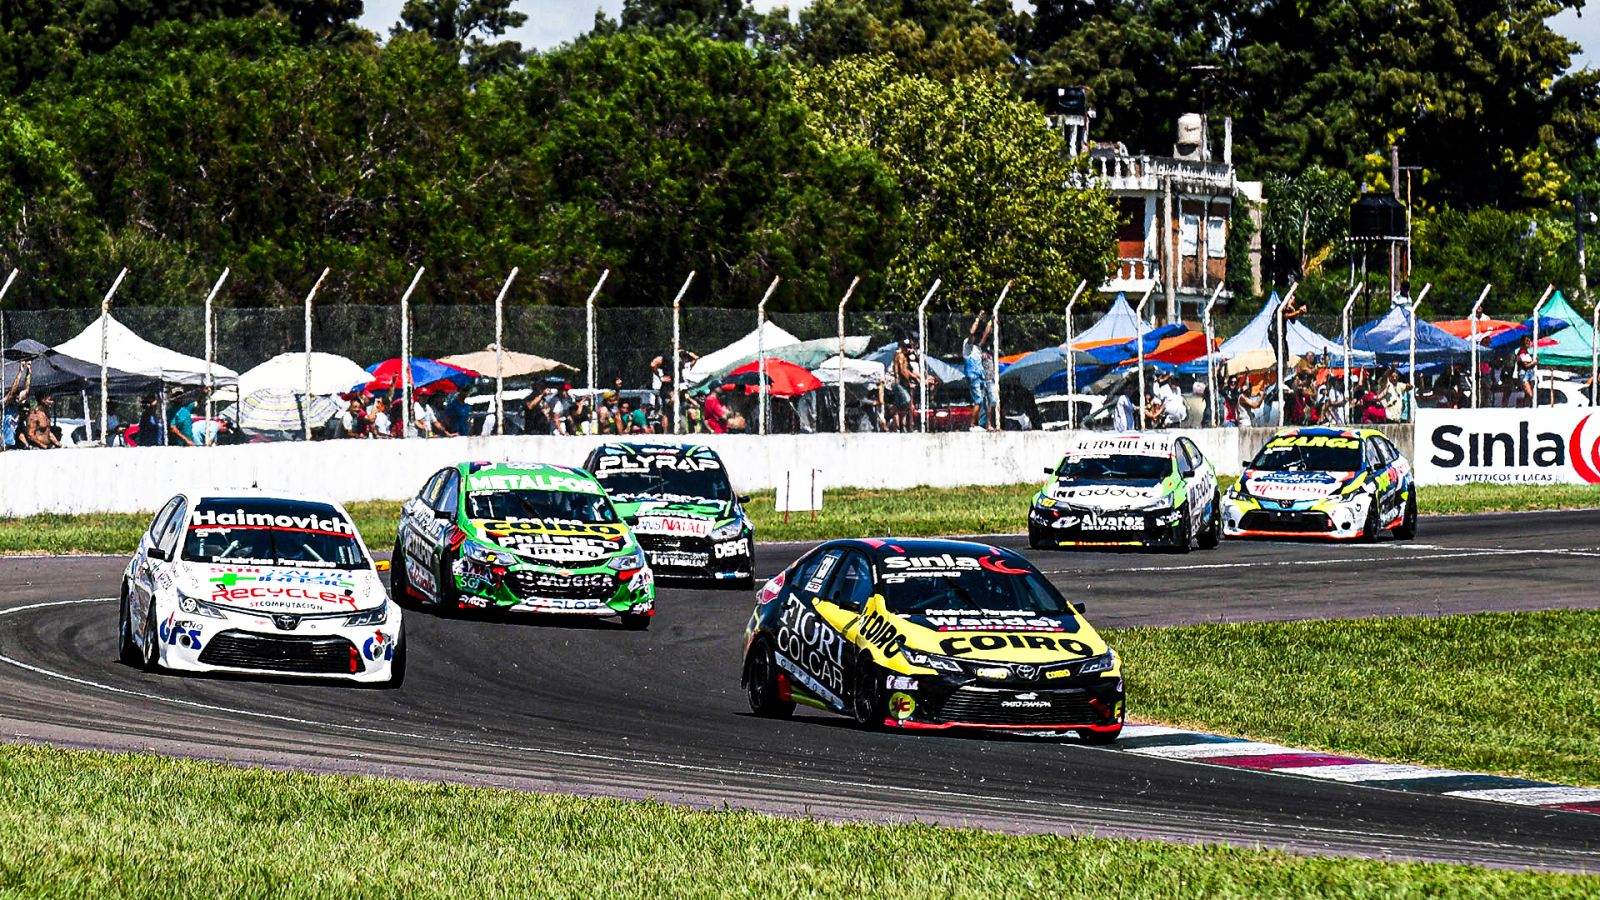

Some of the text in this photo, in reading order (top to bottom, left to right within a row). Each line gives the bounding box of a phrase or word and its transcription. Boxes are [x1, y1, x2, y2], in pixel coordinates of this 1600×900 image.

[1430, 421, 1565, 468] Sinla
[599, 455, 720, 471] PLYRAP
[1455, 474, 1511, 482] SINTETICOS
[1522, 473, 1553, 482] LACAS
[193, 509, 351, 533] Haimovich
[484, 522, 621, 535] COIRO
[1081, 514, 1145, 526] Alvarez
[884, 554, 981, 568] Sinla
[780, 592, 846, 670] FIORI
[926, 616, 1063, 628] Wander
[859, 610, 907, 659] COIRO
[939, 635, 1094, 657] COIRO
[777, 626, 844, 695] COLCAR
